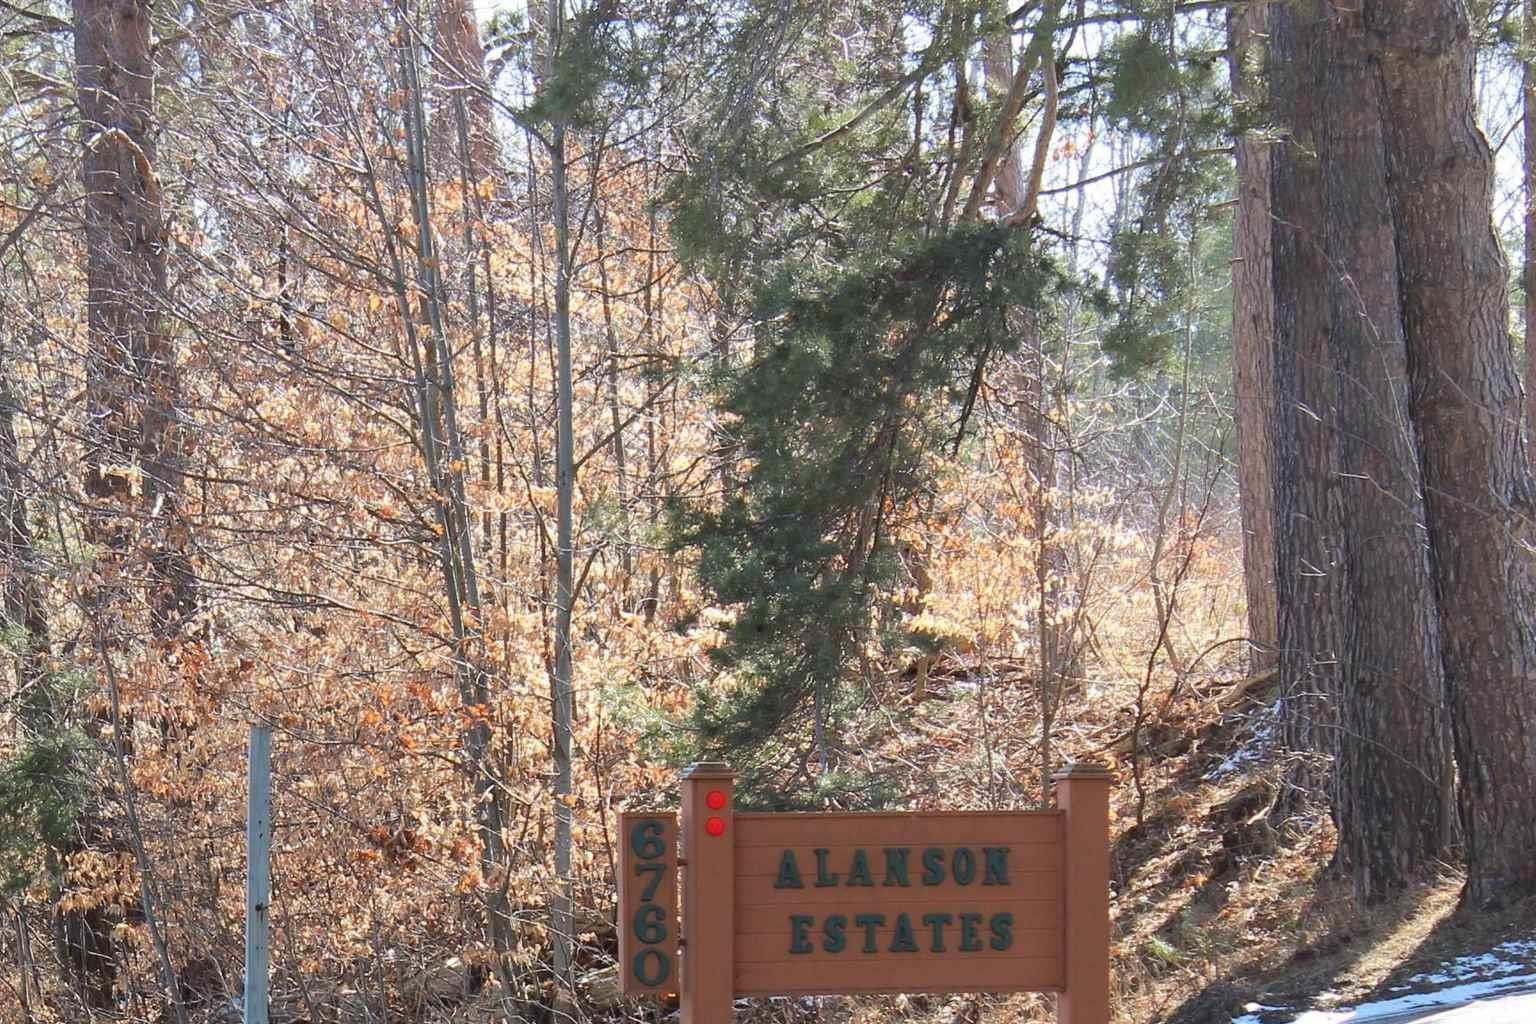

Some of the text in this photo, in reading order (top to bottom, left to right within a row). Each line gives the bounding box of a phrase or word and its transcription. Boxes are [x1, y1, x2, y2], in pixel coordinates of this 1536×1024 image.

[773, 847, 1011, 889] ALANSON
[631, 820, 670, 987] 6760
[788, 912, 1014, 954] ESTATES
